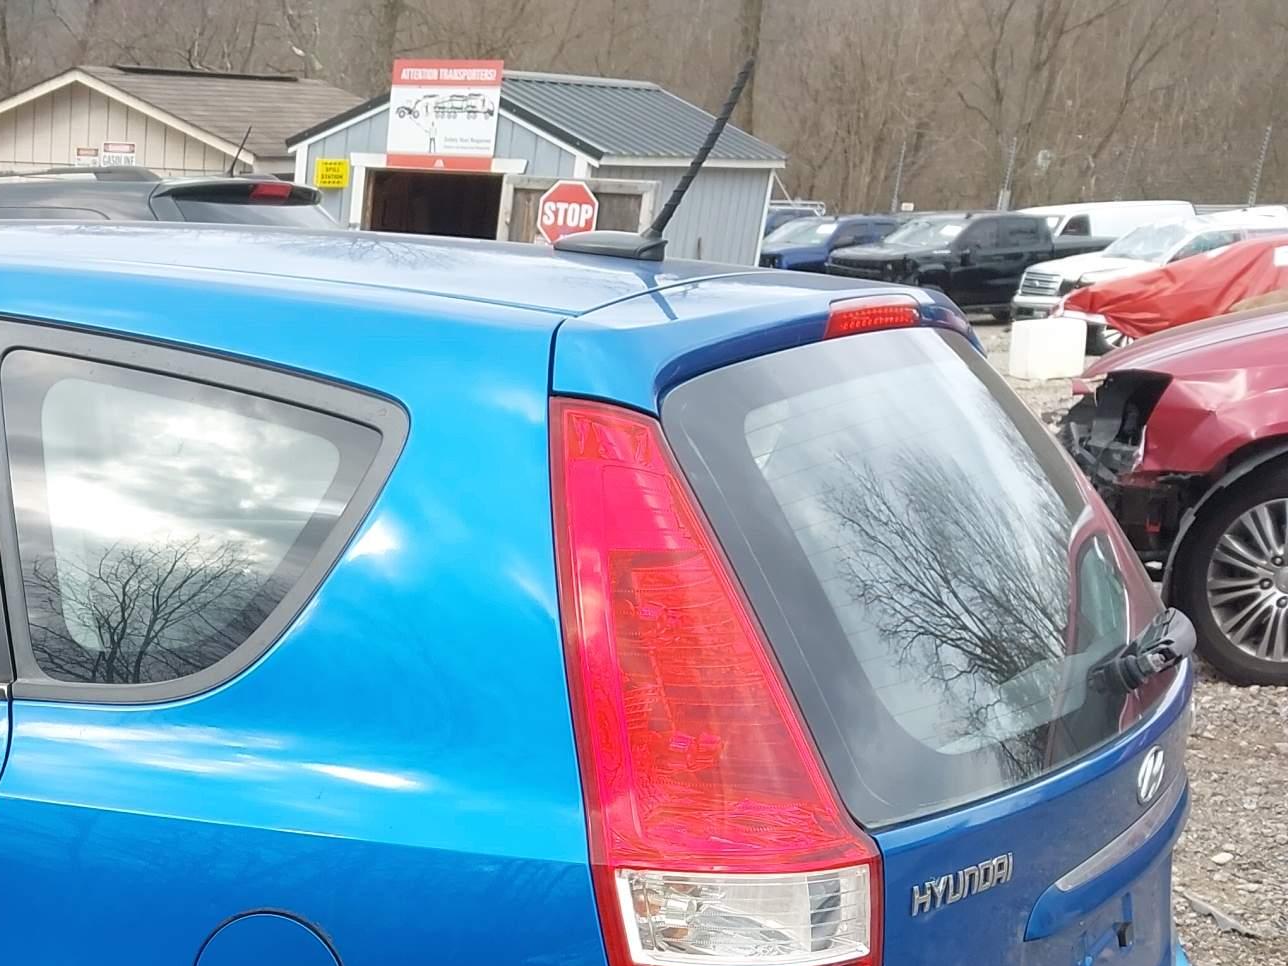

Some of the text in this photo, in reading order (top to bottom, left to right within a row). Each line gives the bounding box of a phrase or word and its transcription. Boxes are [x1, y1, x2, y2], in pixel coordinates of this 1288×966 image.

[400, 68, 438, 80] ATTENTION
[542, 201, 594, 228] STOP
[911, 852, 1014, 917] HYUNDAI
